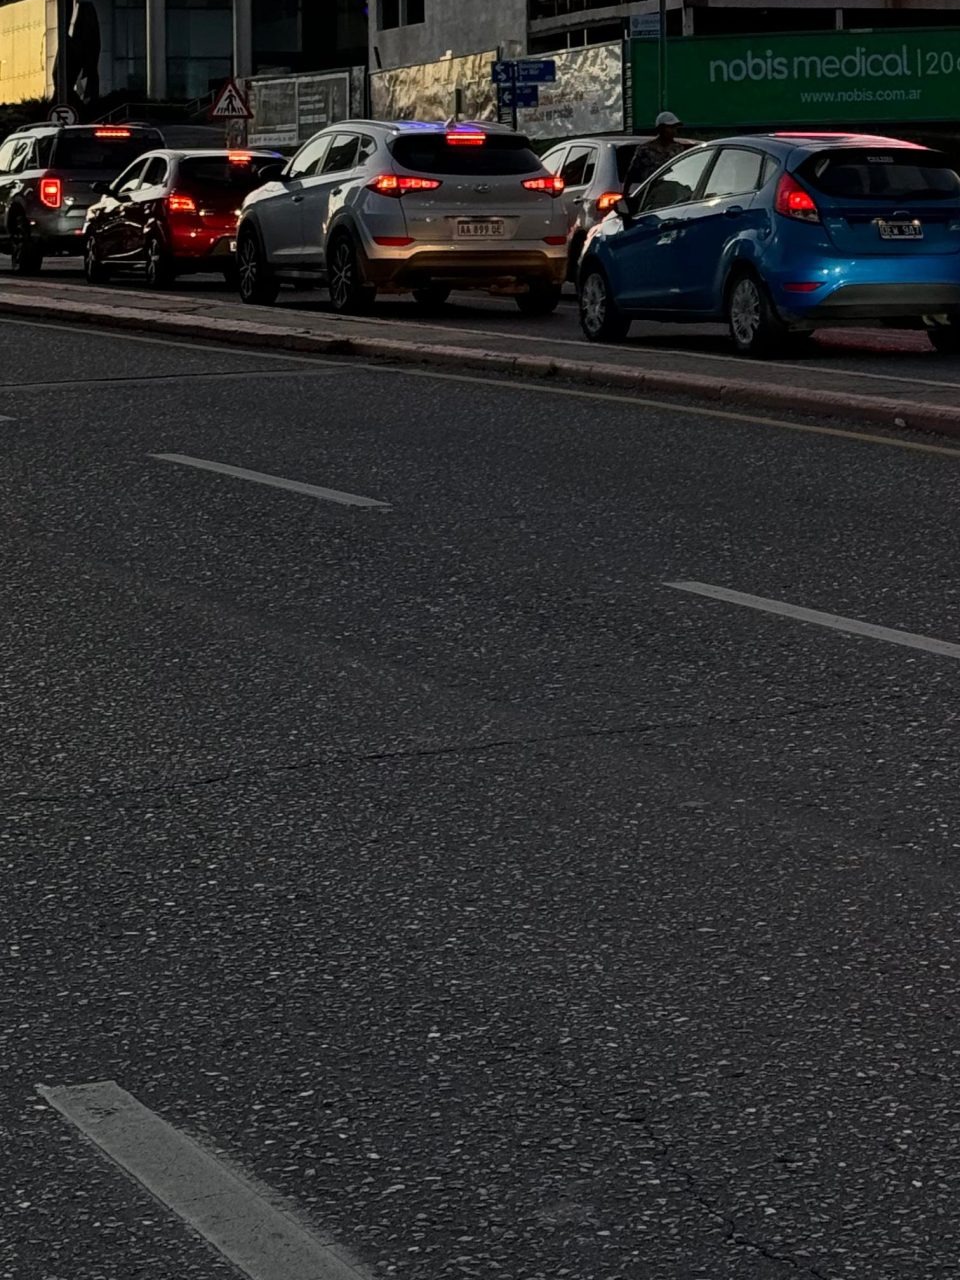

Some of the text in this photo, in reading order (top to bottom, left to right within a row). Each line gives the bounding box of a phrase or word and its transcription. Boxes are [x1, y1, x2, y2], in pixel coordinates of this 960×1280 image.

[709, 48, 788, 83] nobis
[793, 44, 912, 80] medical
[800, 88, 923, 104] www.nobis.com.ar
